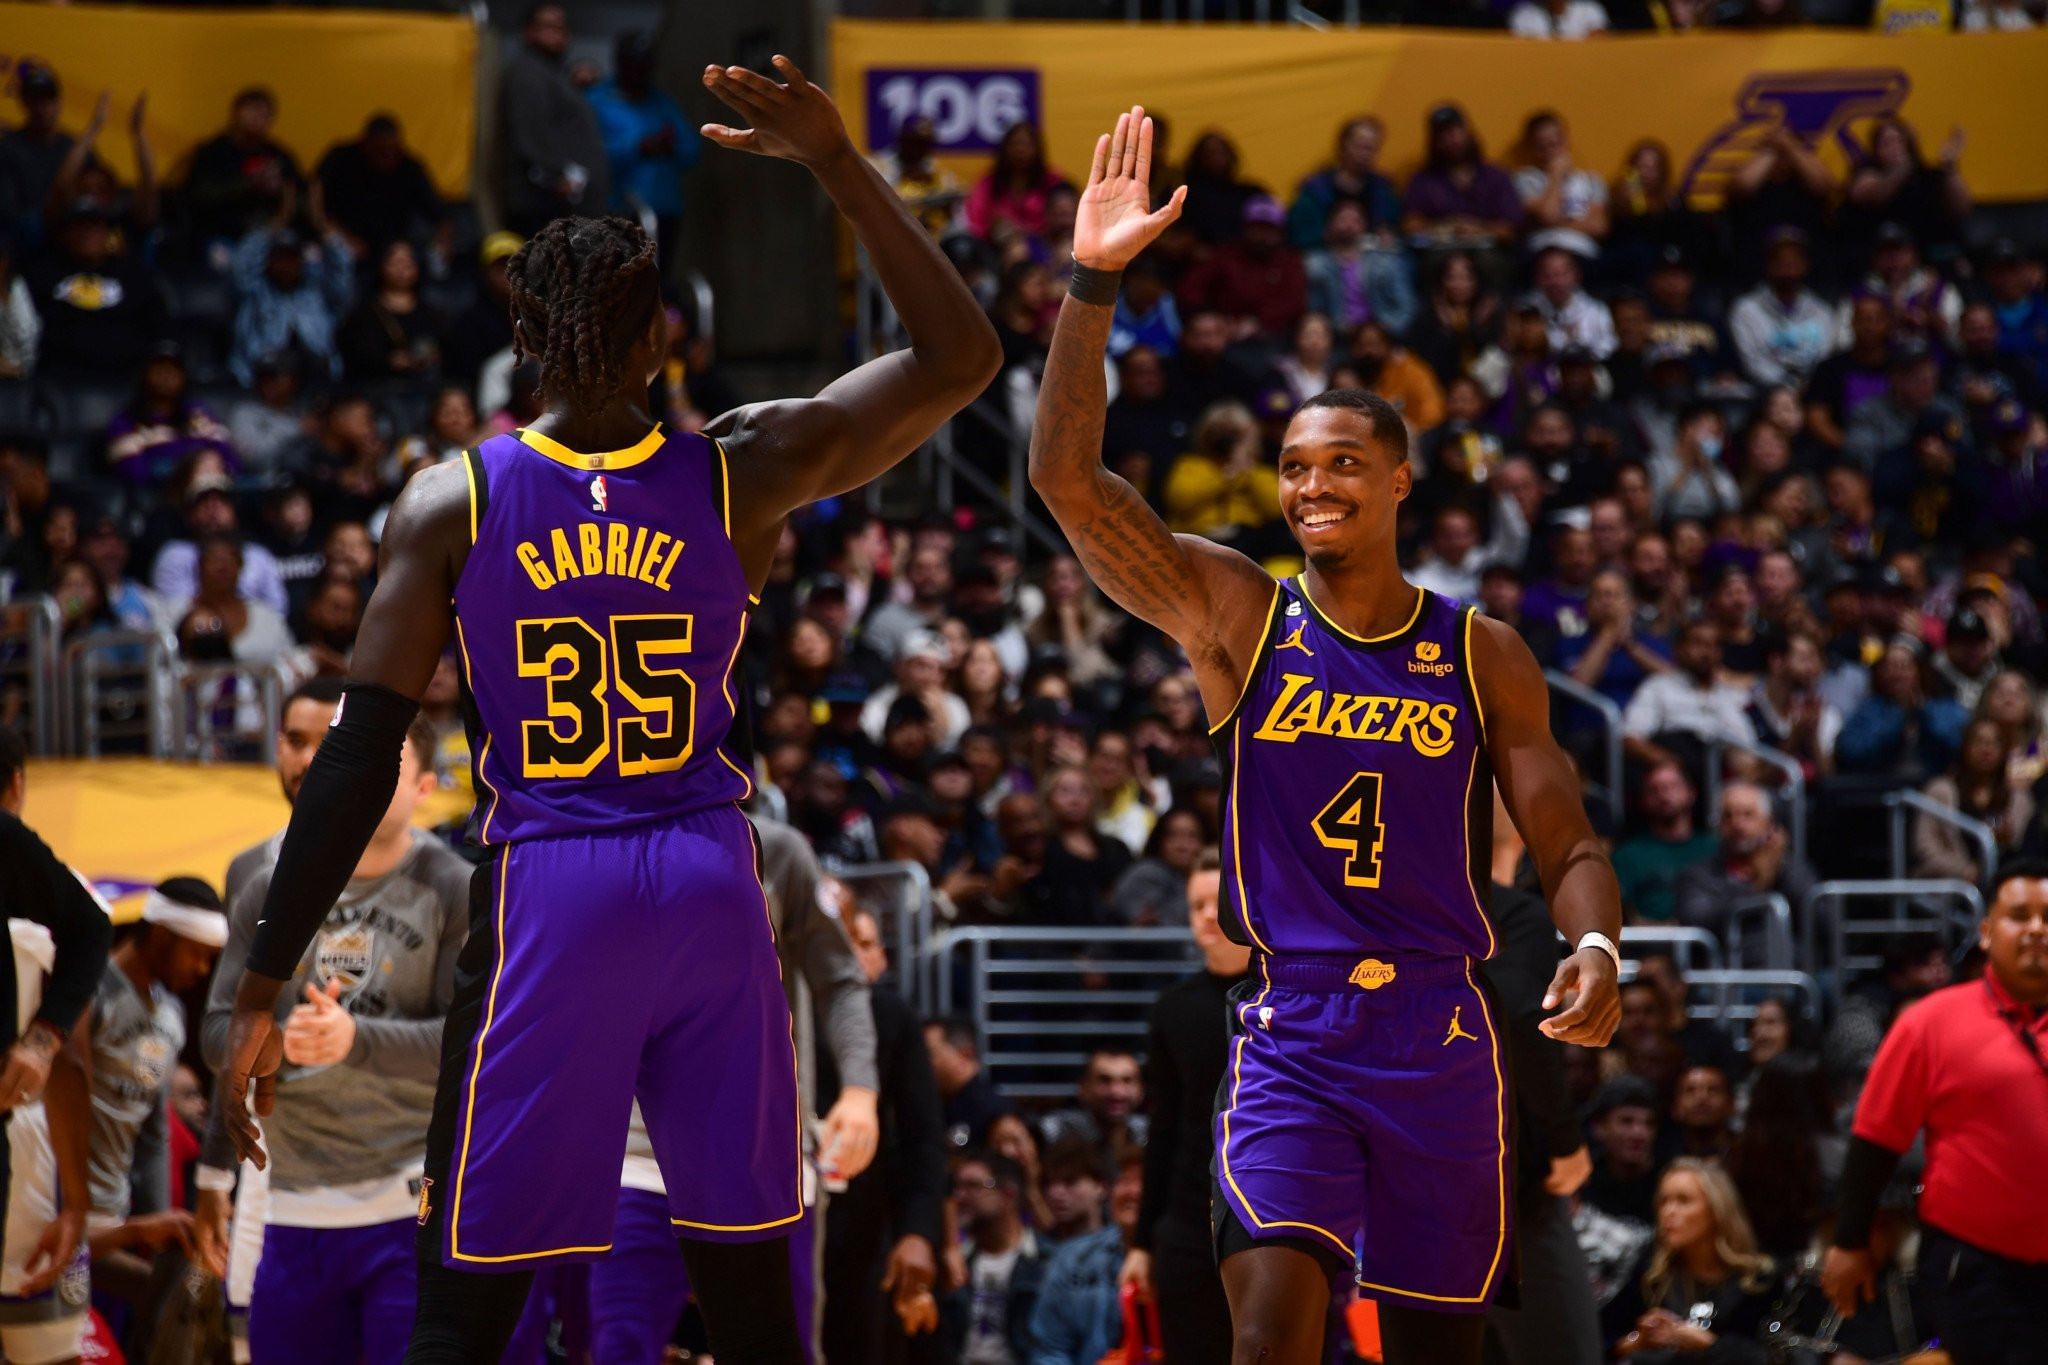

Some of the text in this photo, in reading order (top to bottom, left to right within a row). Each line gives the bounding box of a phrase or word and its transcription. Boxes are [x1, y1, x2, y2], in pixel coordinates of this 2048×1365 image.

[880, 75, 1028, 146] 106
[516, 523, 685, 591] GABRIEL
[516, 614, 696, 778] 35
[1408, 661, 1454, 677] bibigo
[1253, 673, 1457, 758] LAKERS
[1311, 771, 1385, 889] 4
[1353, 967, 1391, 982] LAKERS
